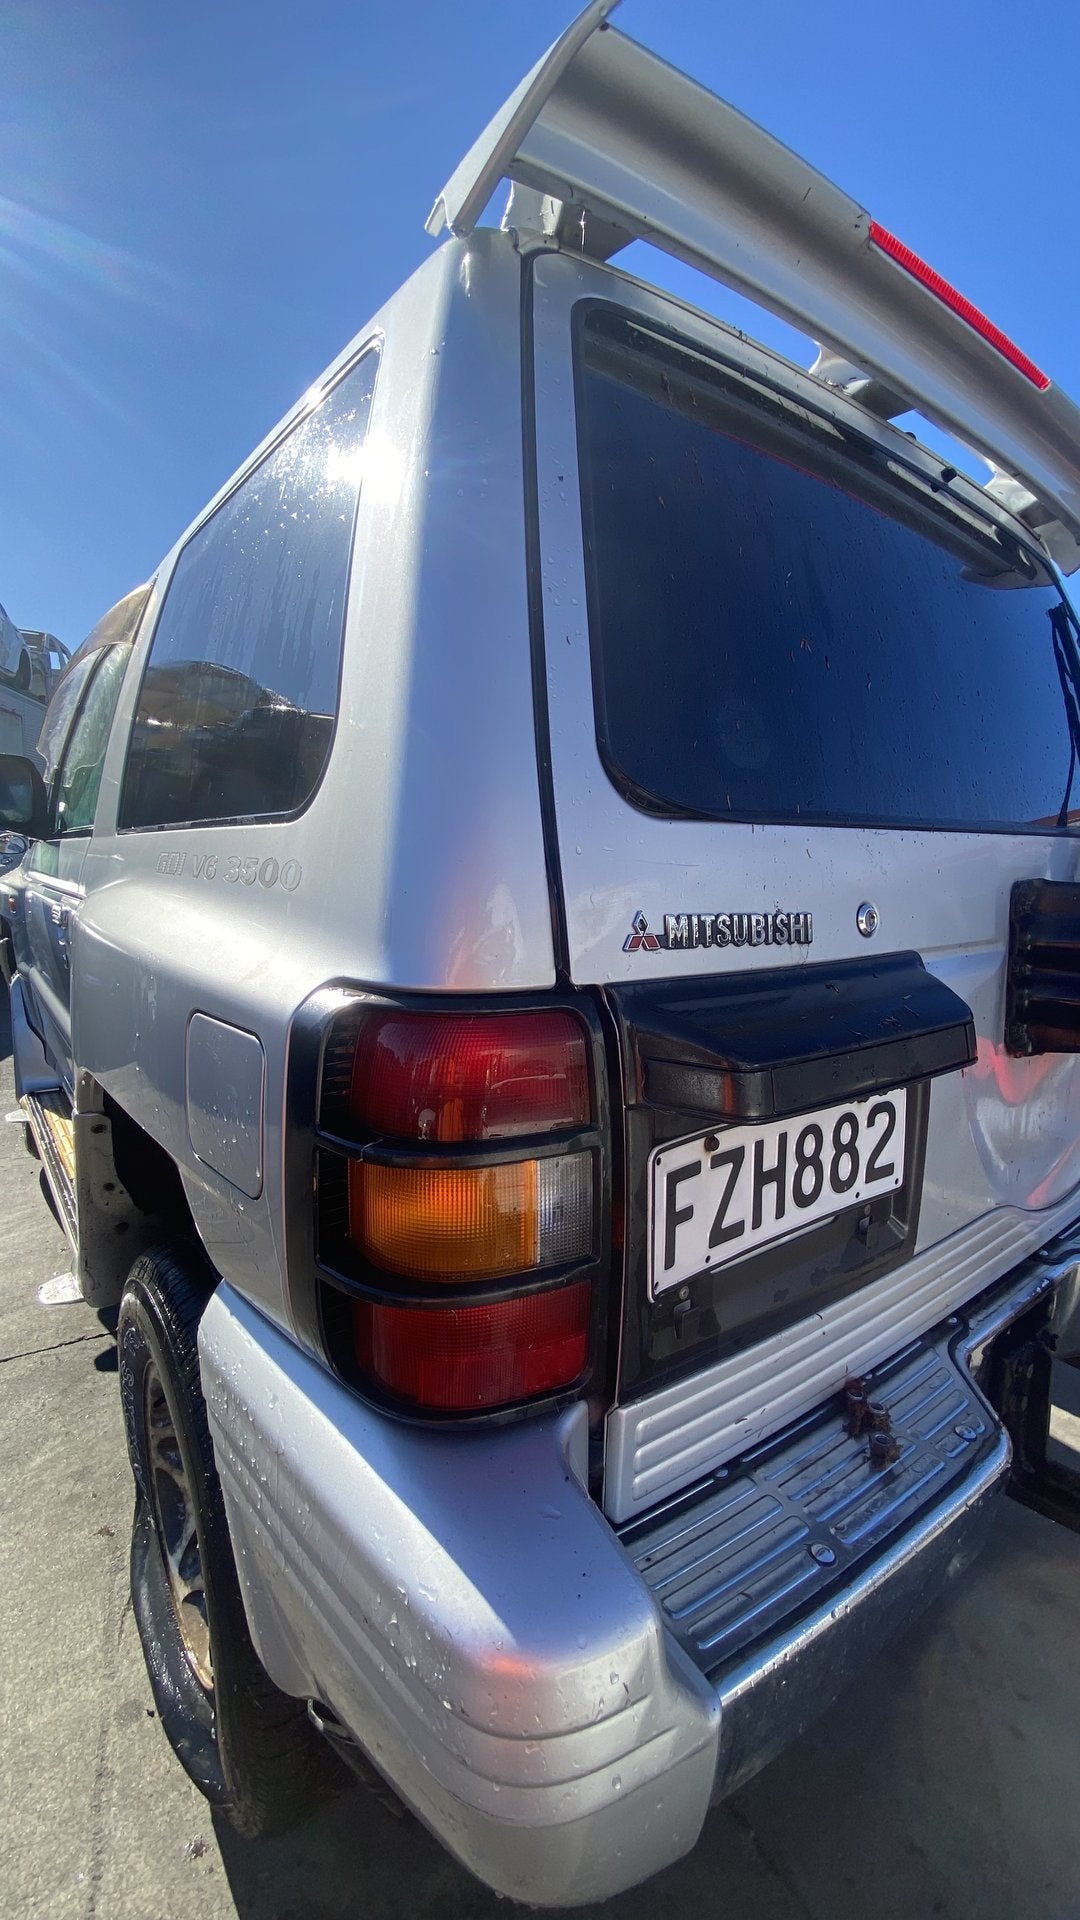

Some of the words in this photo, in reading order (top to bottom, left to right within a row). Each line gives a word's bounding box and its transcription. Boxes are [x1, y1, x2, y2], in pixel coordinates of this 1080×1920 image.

[156, 852, 187, 876] GDI
[193, 855, 219, 881] V6
[223, 856, 303, 892] 3500
[664, 914, 813, 950] MITSUBISHI
[664, 1100, 897, 1271] FZH882
